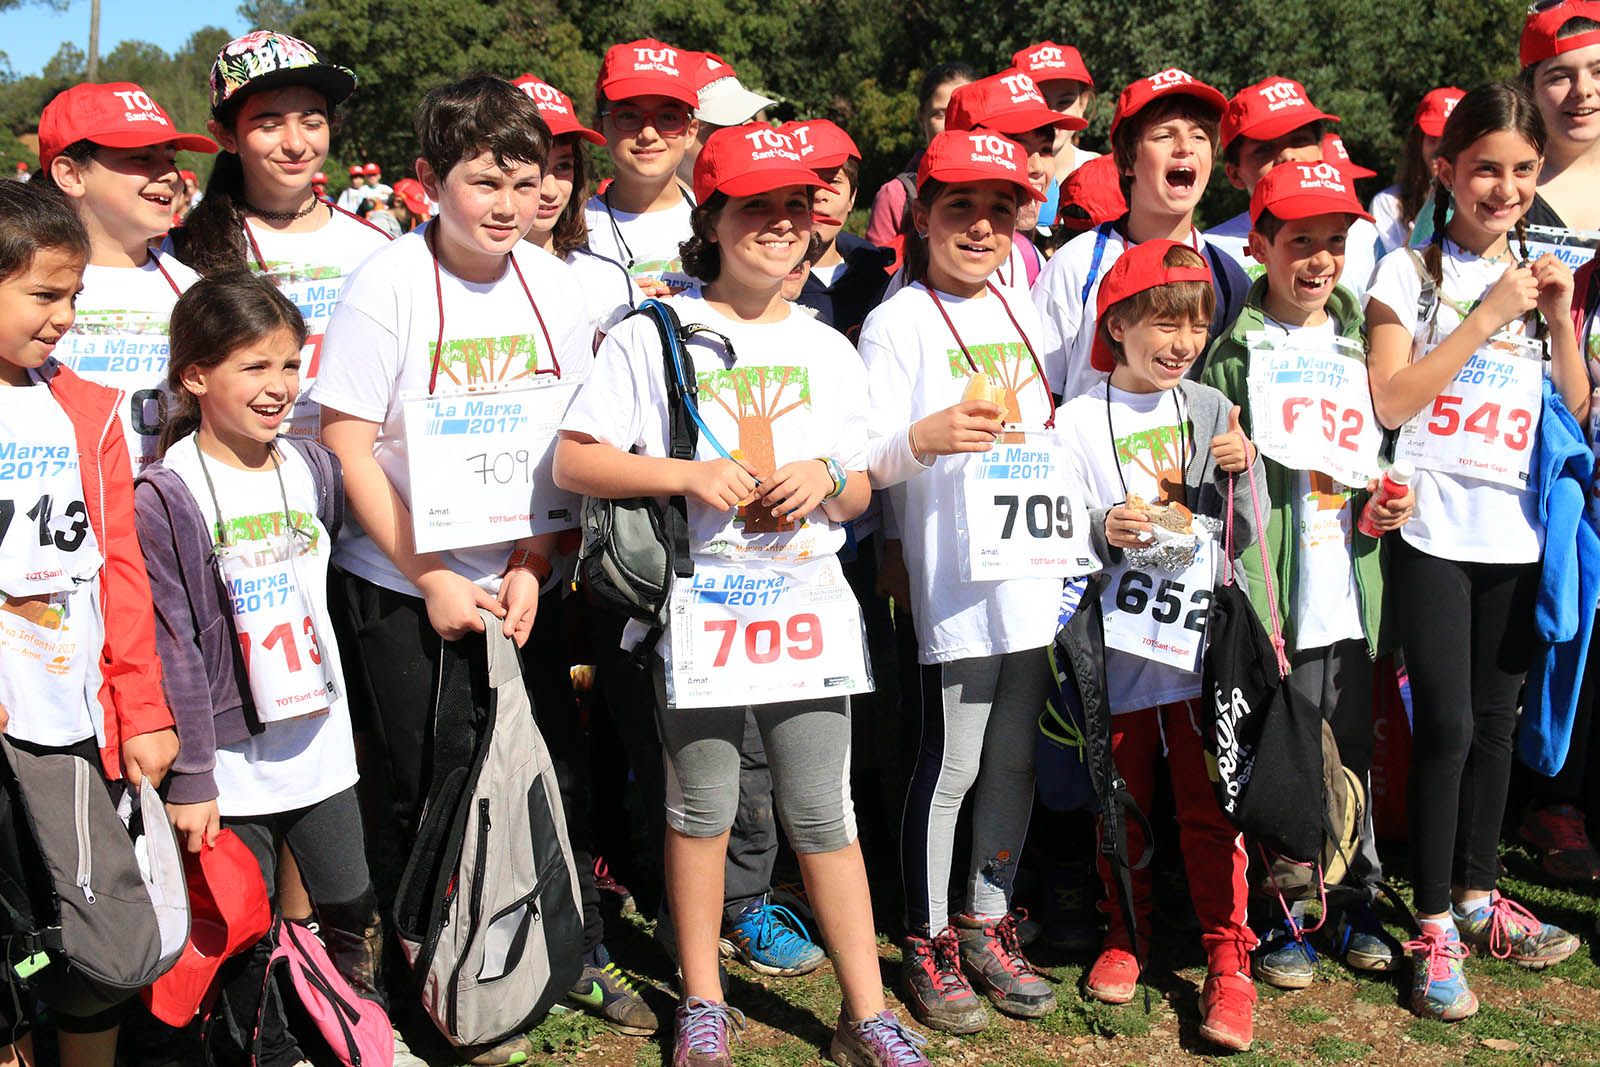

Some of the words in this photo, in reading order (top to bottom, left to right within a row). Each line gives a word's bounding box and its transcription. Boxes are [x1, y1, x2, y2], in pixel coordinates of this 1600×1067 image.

[1029, 47, 1062, 62] TOT
[1148, 69, 1193, 85] TOT
[1260, 82, 1299, 103] TOT
[744, 129, 795, 151] TOT
[968, 135, 1016, 160] TOT
[1297, 163, 1342, 182] TOT
[464, 400, 522, 417] Marxa
[1428, 394, 1532, 452] 543
[1006, 447, 1050, 463] Marxa
[466, 449, 529, 485] 709
[994, 494, 1074, 540] 709
[227, 571, 289, 597] Marxa
[723, 574, 785, 591] Marxa
[1116, 570, 1214, 633] 652
[703, 613, 823, 668] 709
